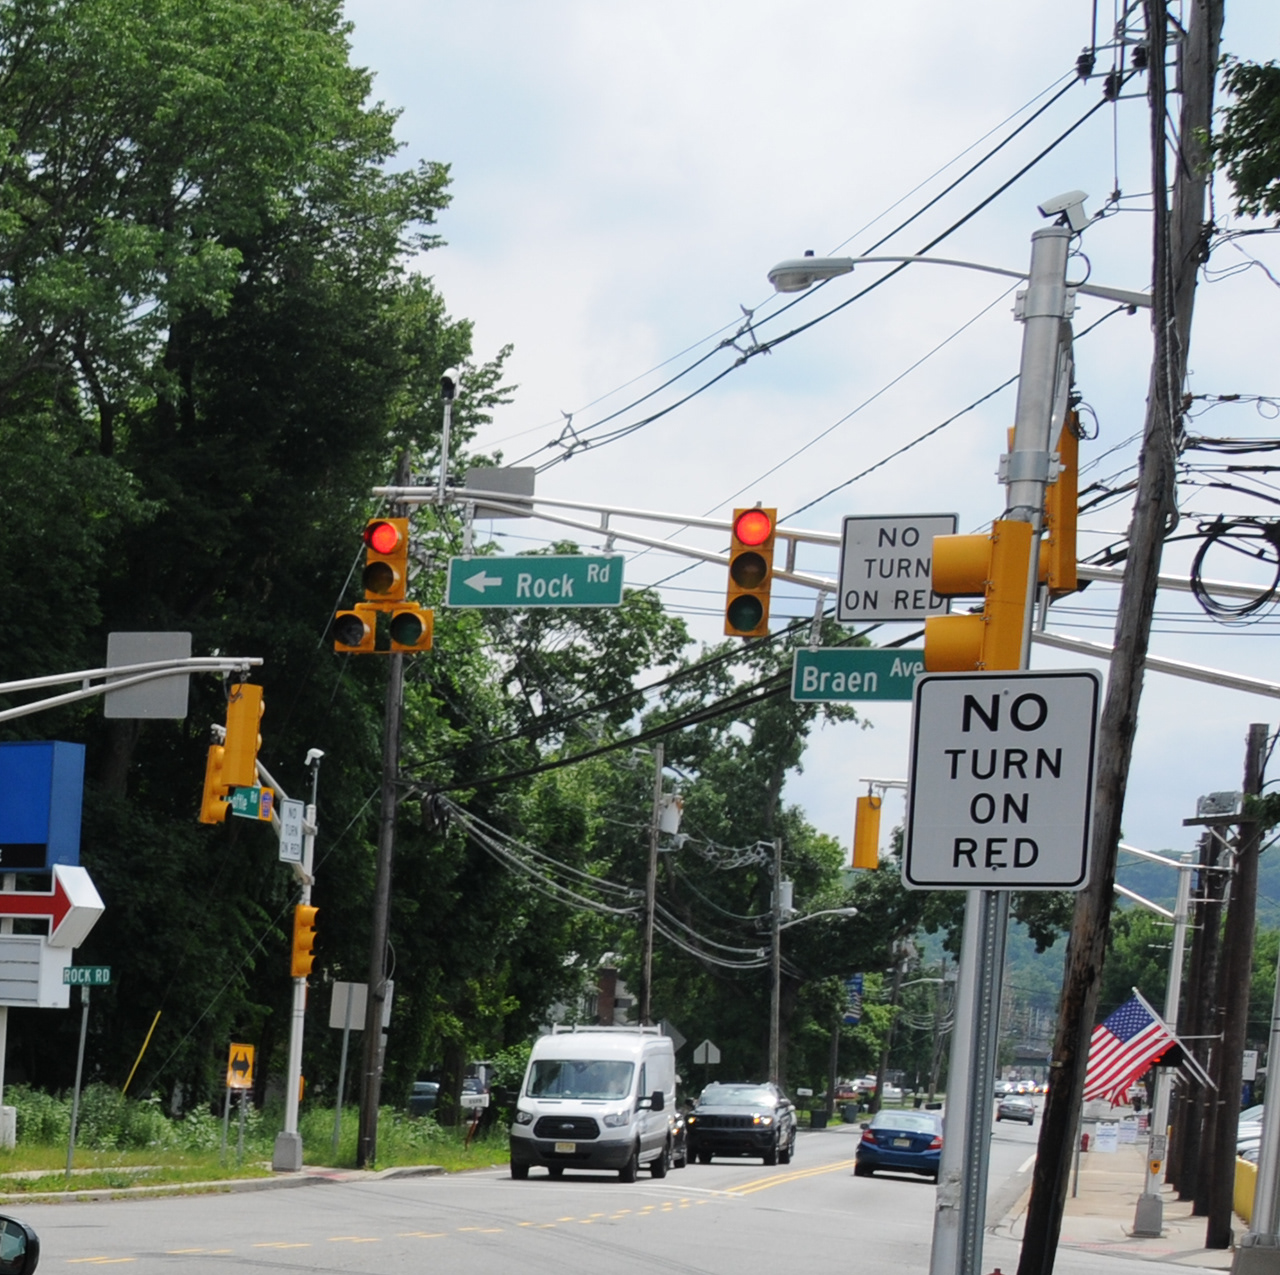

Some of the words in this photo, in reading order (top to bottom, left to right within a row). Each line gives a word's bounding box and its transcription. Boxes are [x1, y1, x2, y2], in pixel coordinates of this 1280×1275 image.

[878, 527, 920, 548] NO
[516, 573, 575, 598] Rock
[587, 564, 610, 583] Rd
[864, 558, 931, 579] TURN
[845, 590, 878, 610] ON
[894, 589, 944, 610] RED
[802, 666, 878, 692] Braen
[889, 657, 924, 678] Ave
[962, 692, 1048, 732] NO
[944, 748, 1062, 779] TURN
[970, 792, 1029, 824] ON
[952, 837, 1039, 868] RED
[64, 968, 91, 983] ROCK
[95, 969, 110, 982] RD
